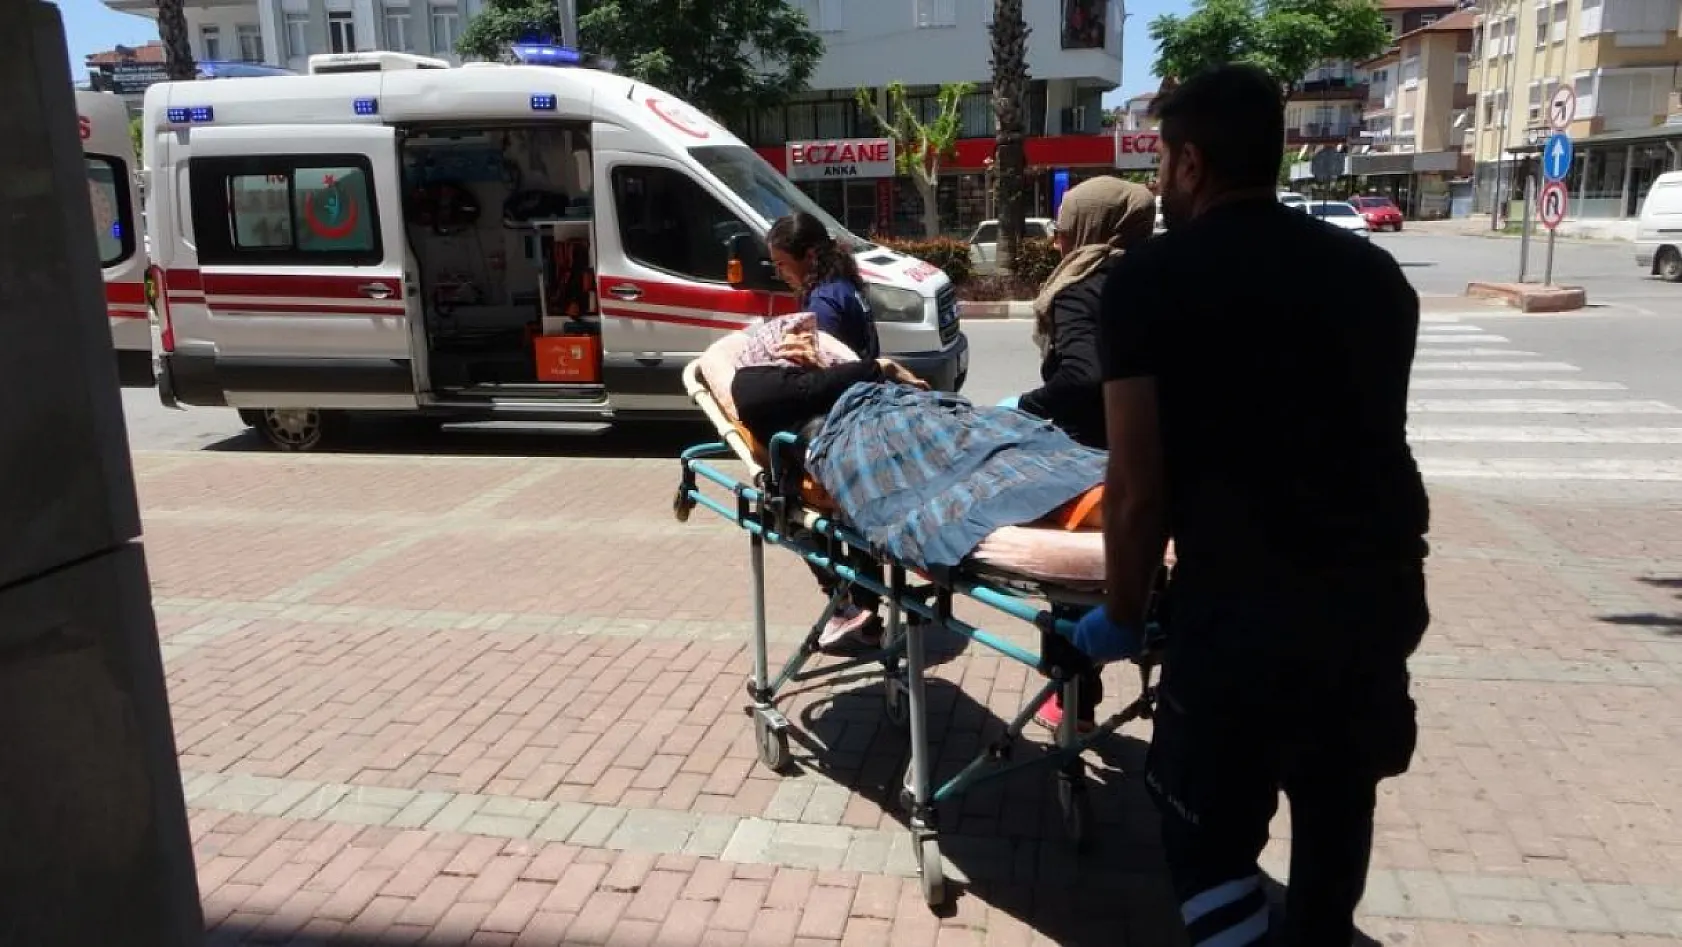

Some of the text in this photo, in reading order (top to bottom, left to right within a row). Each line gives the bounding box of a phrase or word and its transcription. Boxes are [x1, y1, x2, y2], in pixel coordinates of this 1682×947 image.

[792, 142, 889, 164] ECZANE
[1122, 134, 1159, 153] ECZ
[824, 166, 857, 176] ANKA
